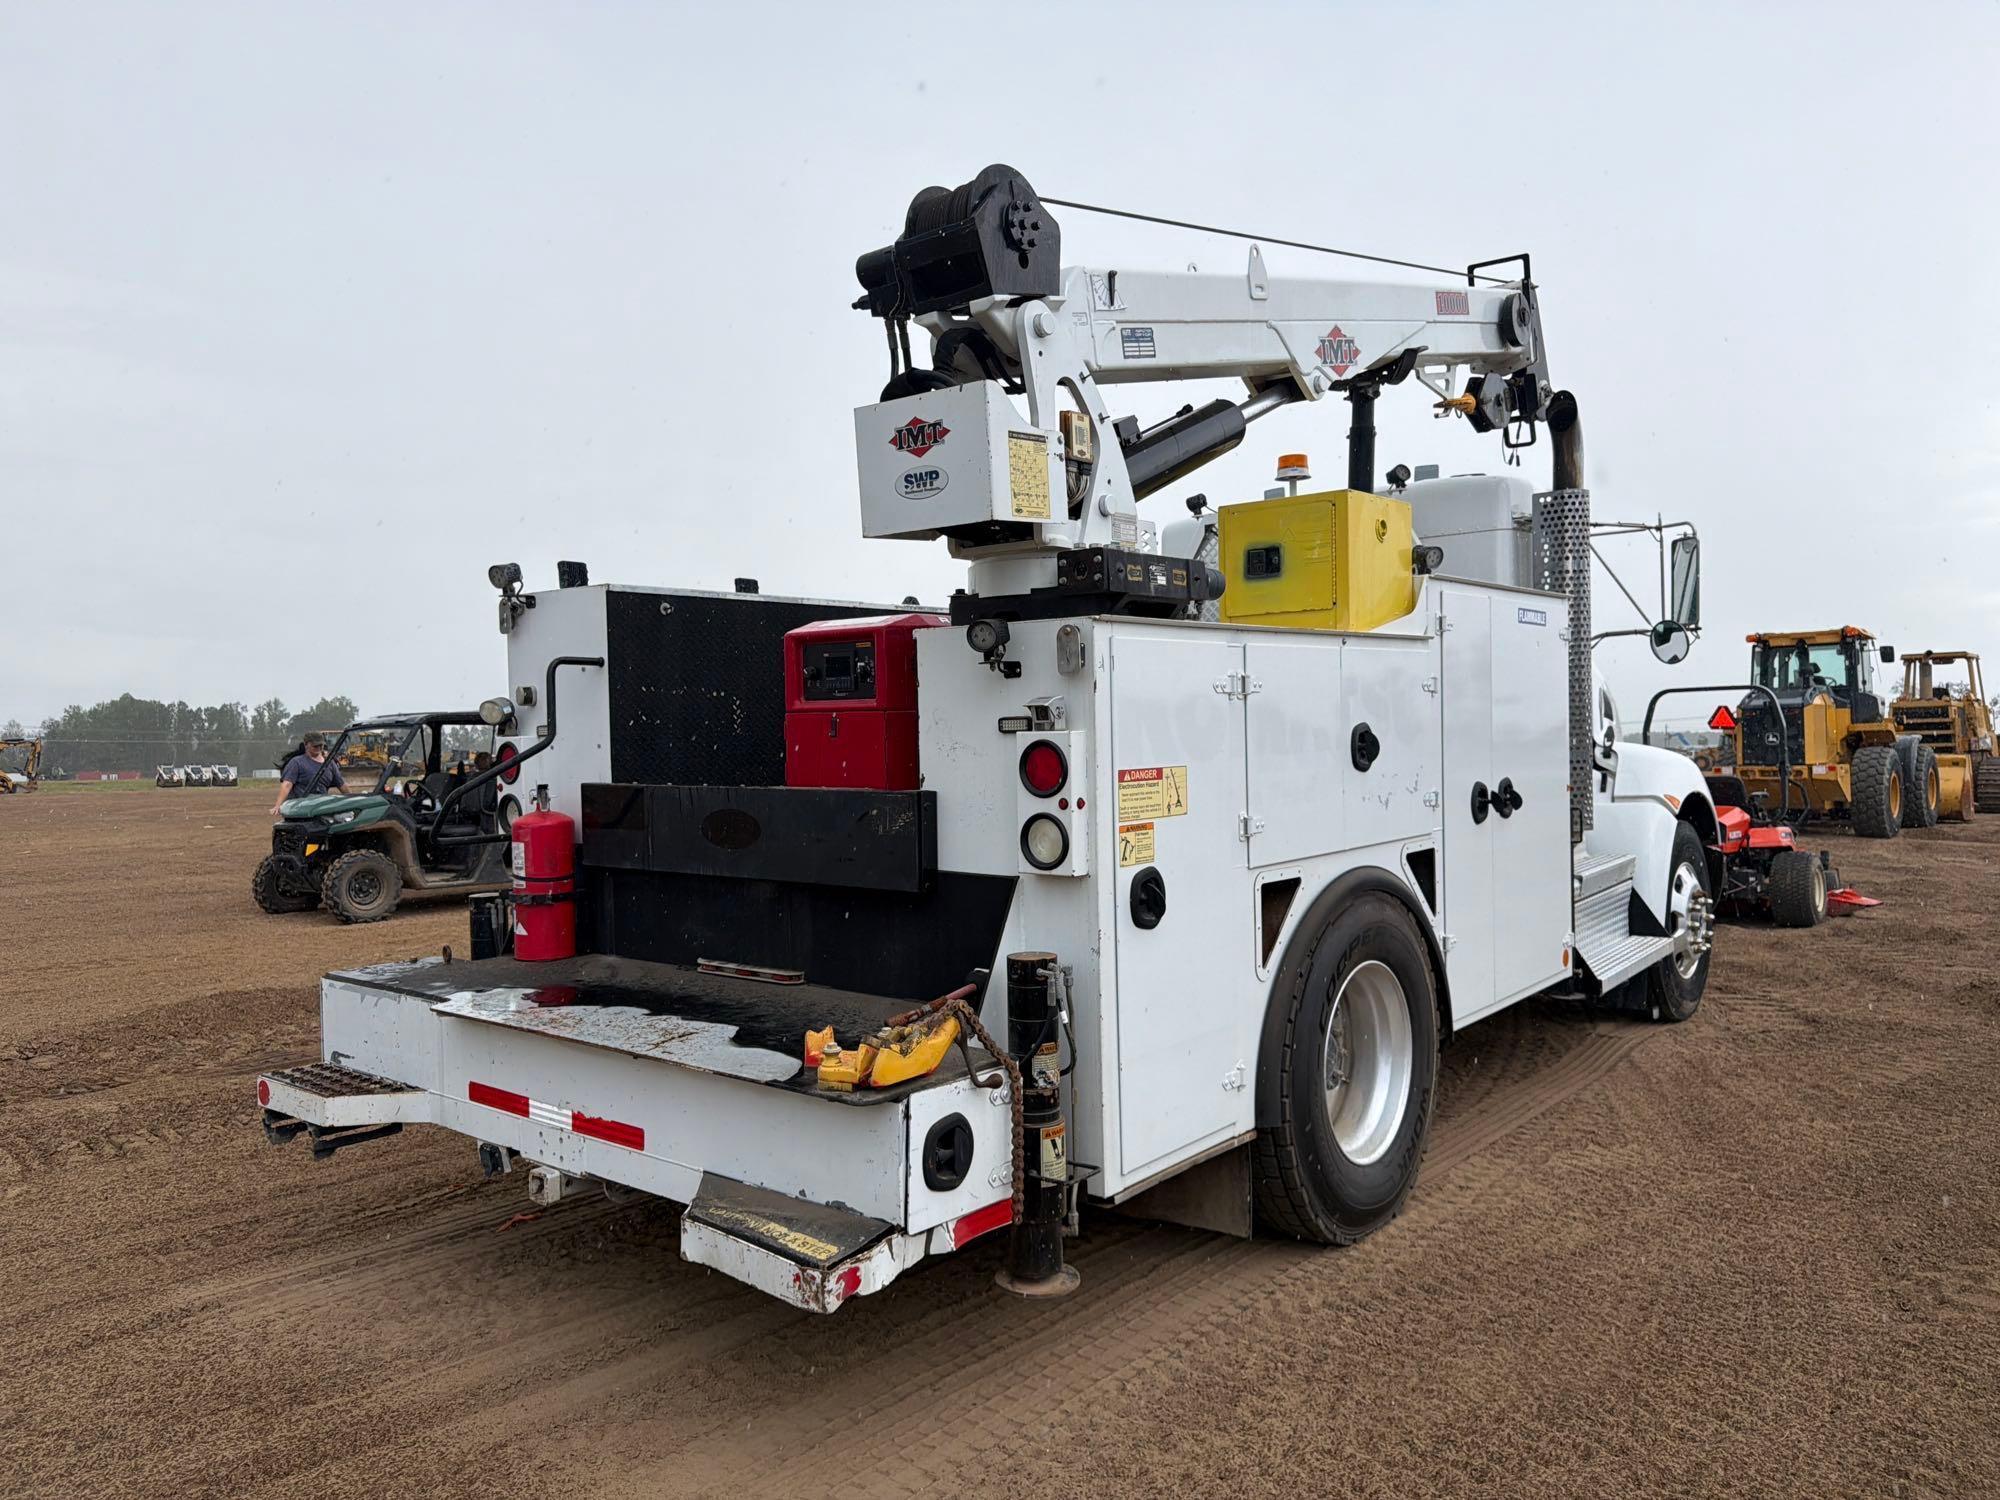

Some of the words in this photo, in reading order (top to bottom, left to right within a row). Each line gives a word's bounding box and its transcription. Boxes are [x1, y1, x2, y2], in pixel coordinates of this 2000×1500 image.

[1319, 337, 1356, 366] IMT
[895, 419, 943, 451] IMT
[903, 470, 940, 489] SWP
[1131, 769, 1158, 780] DANGER
[797, 1239, 832, 1257] STEP
